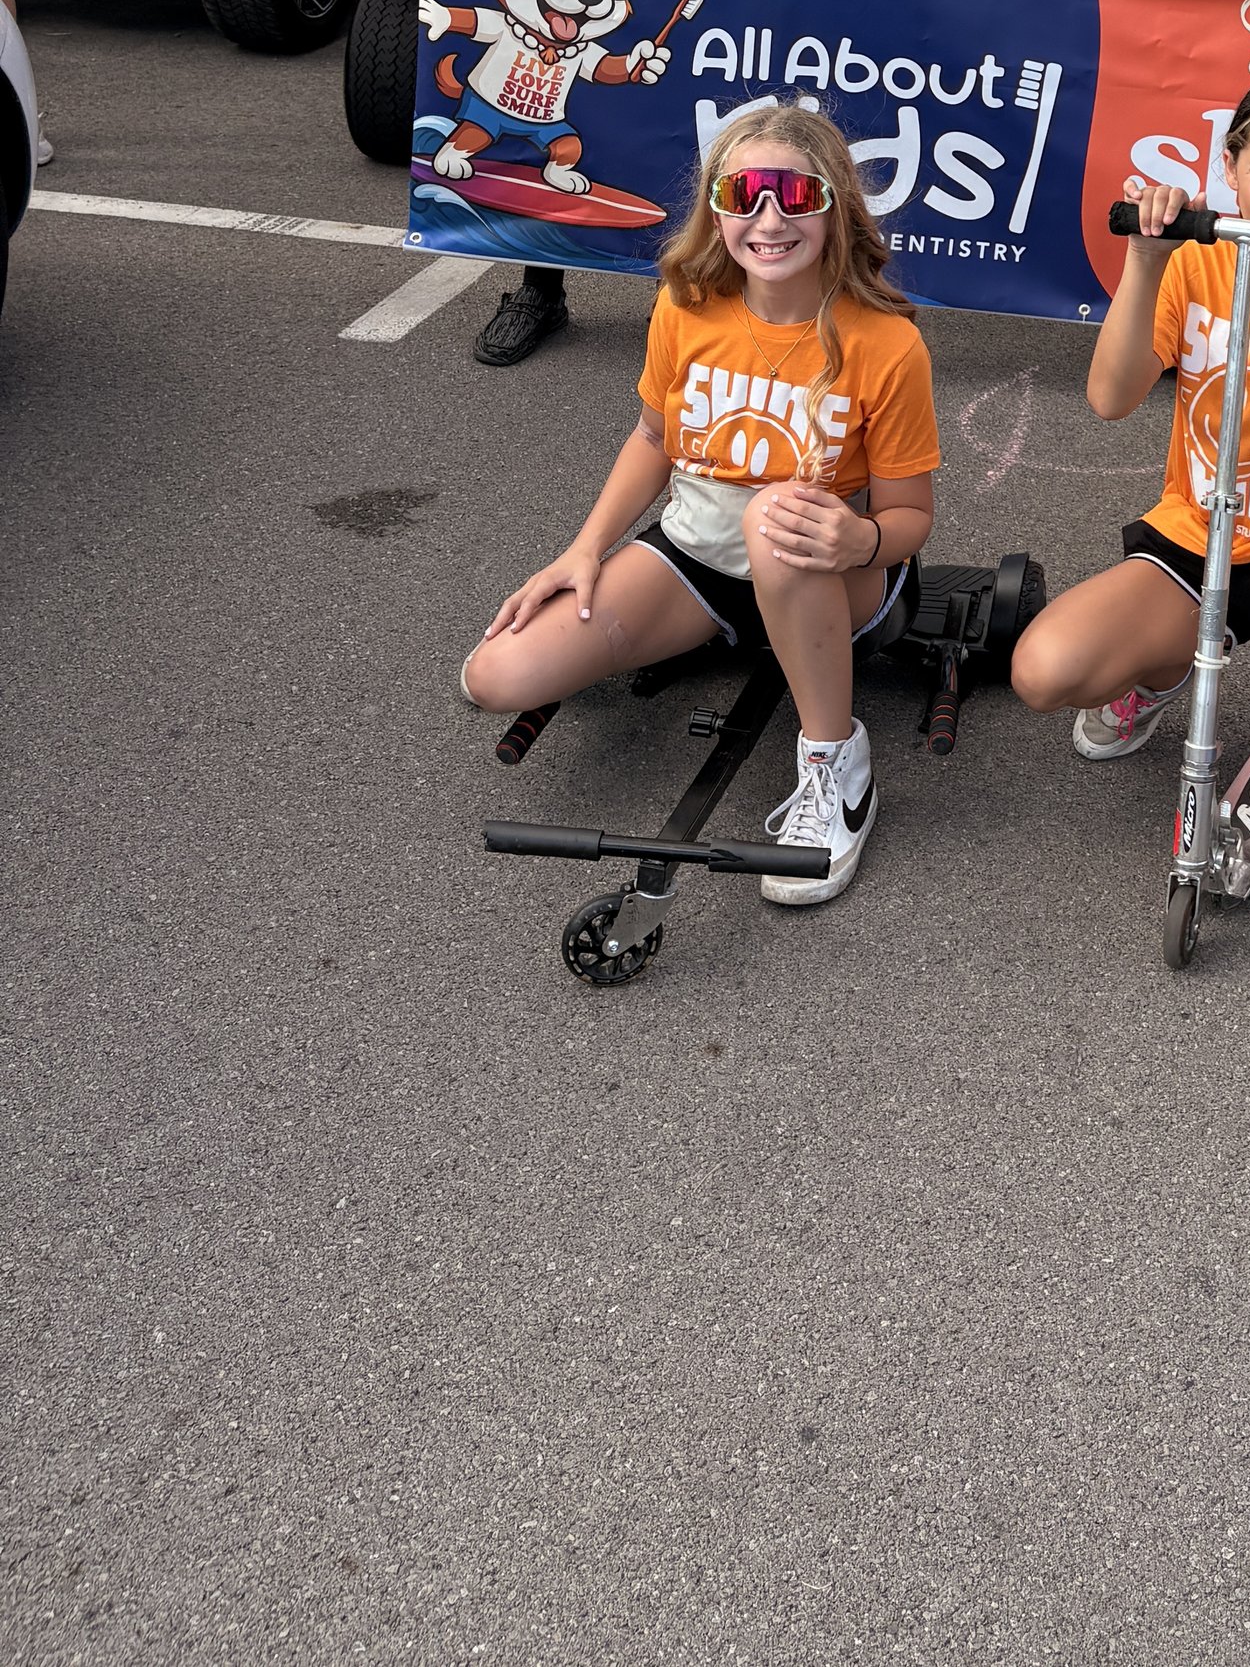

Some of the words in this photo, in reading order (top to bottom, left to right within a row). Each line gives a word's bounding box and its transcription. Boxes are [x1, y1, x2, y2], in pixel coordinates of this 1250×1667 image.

[513, 50, 567, 81] LIVE
[692, 26, 773, 83] All
[784, 37, 1005, 109] About
[503, 80, 558, 109] SURF
[507, 66, 562, 97] LOVE
[496, 93, 555, 121] SMILE
[880, 233, 1027, 264] ENTISTRY
[680, 362, 851, 457] SHINE
[1183, 791, 1195, 848] Micro
